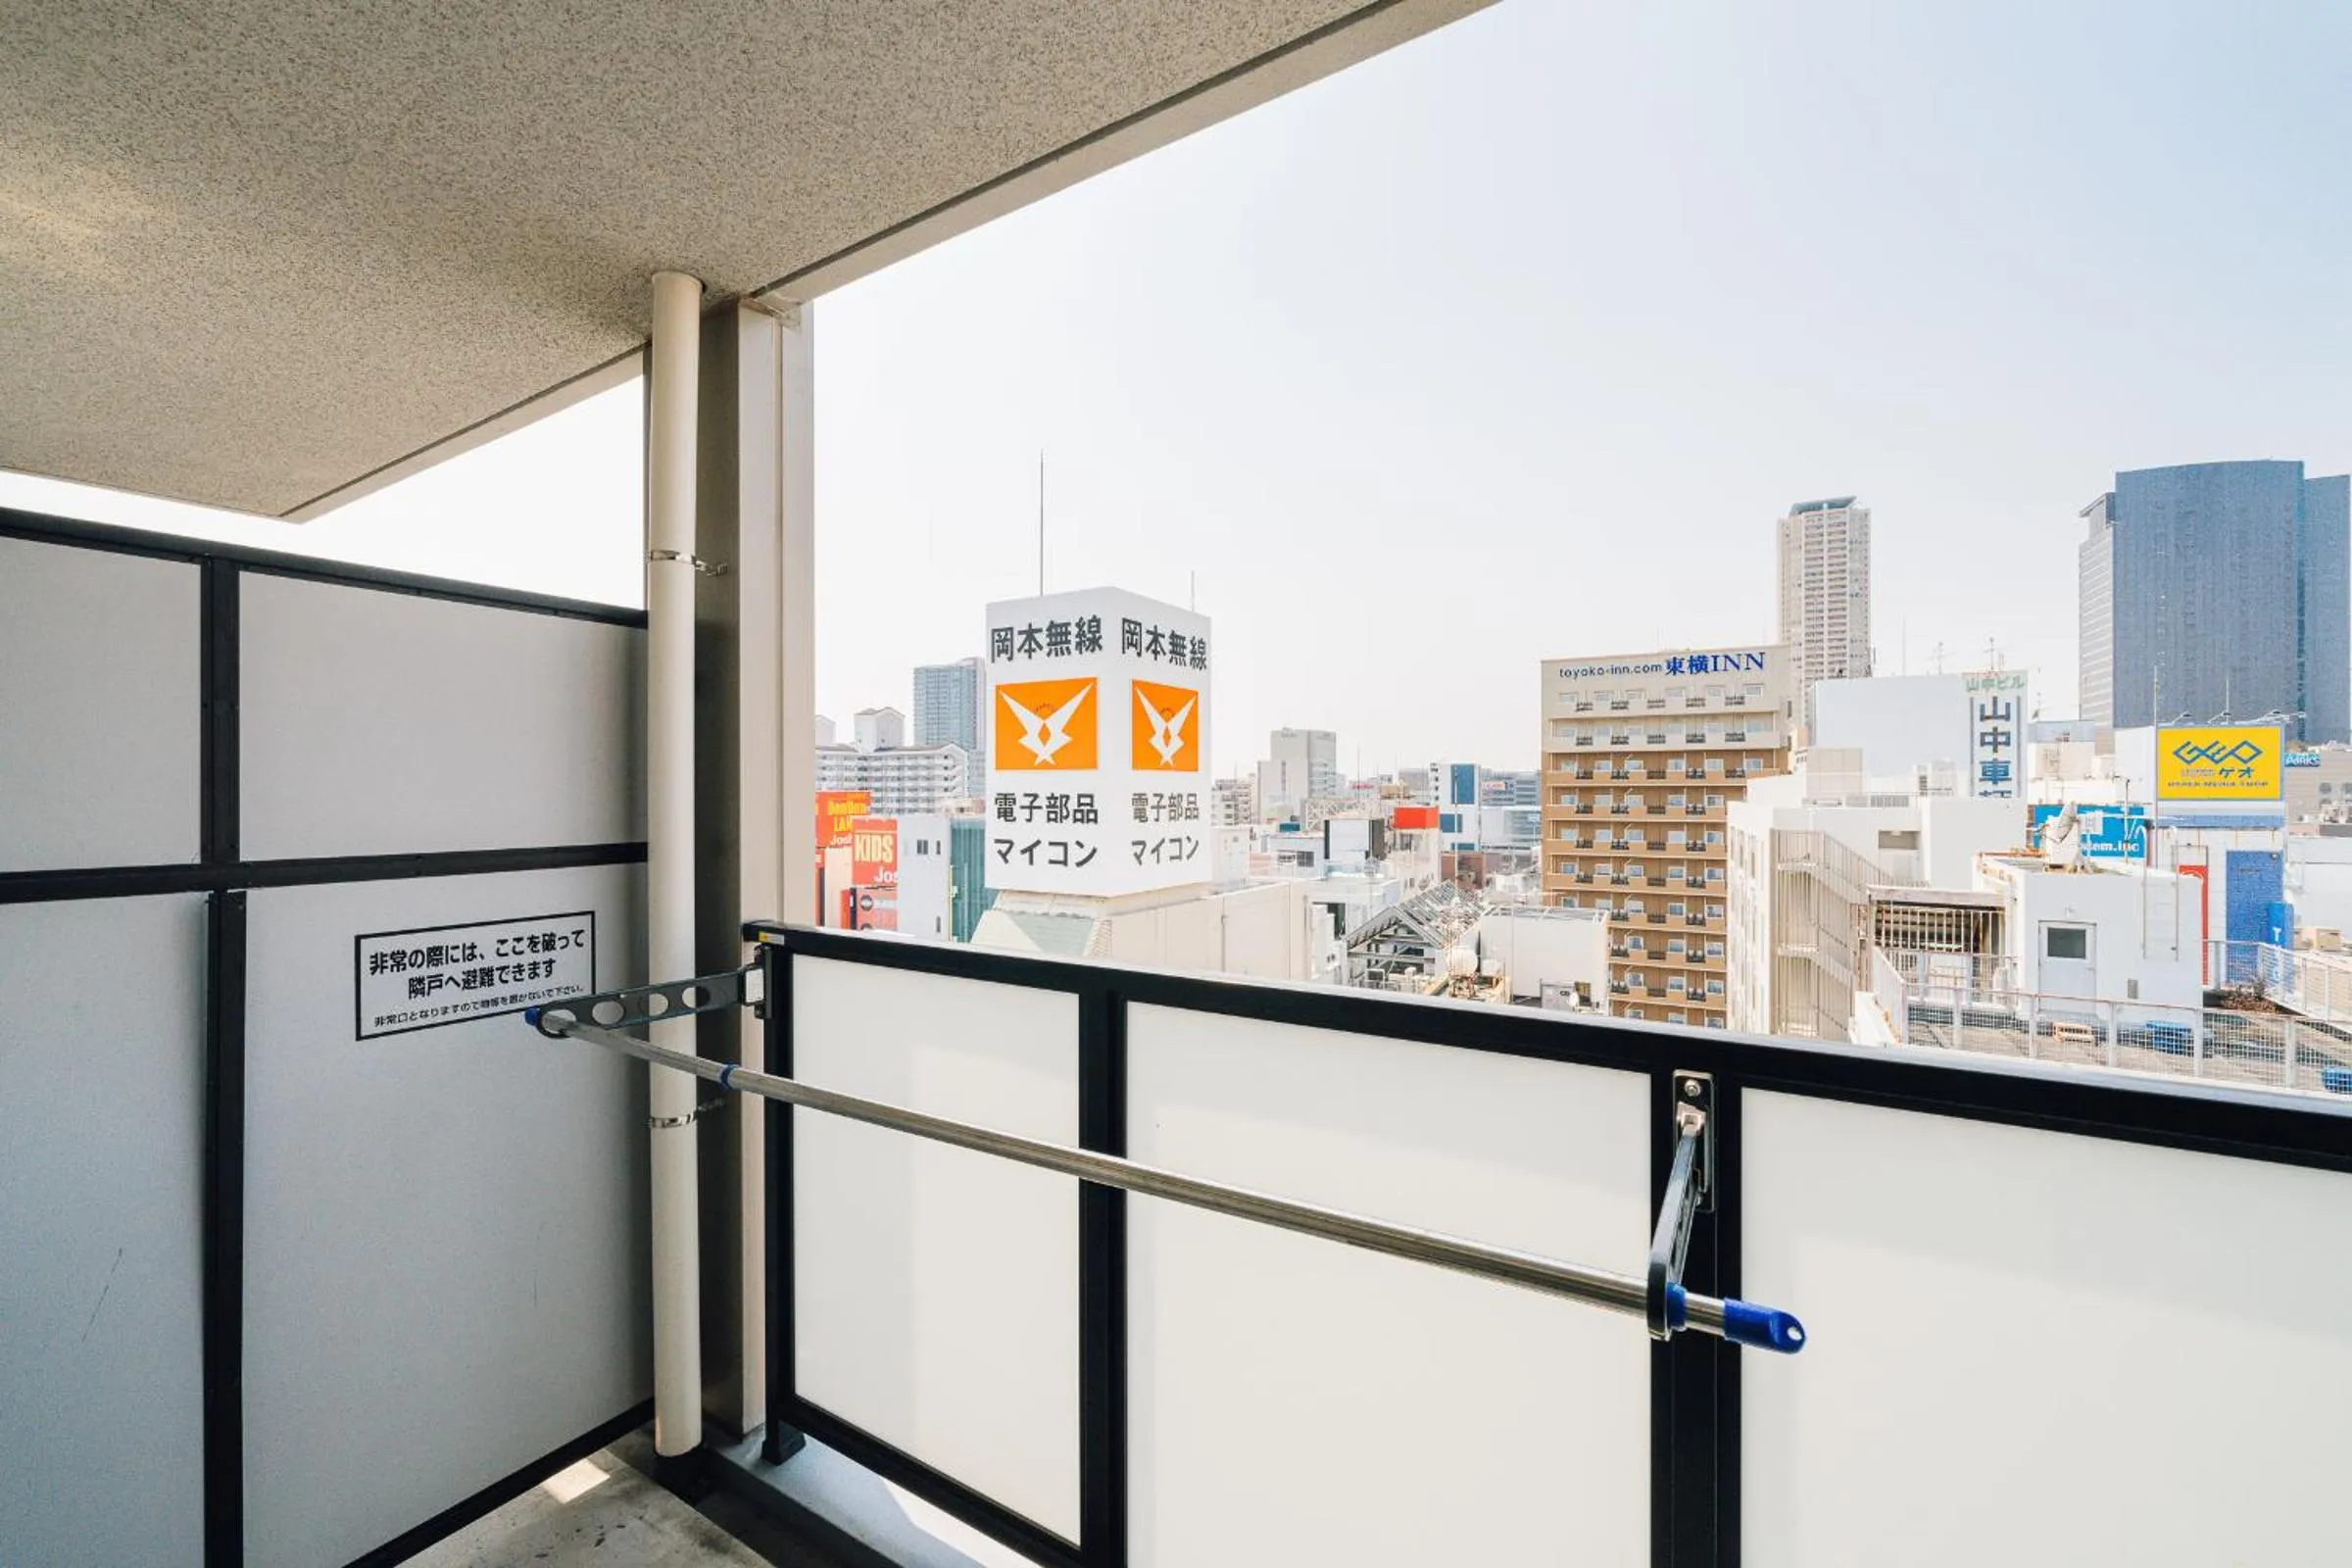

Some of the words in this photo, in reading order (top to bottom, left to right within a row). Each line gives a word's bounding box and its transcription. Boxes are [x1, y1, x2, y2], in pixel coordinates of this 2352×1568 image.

[991, 614, 1103, 663] 岡本無線
[1121, 616, 1207, 671] 岡本無線
[1559, 662, 1663, 680] toyoko-inn.com
[1666, 652, 1766, 676] 東横INN
[2173, 740, 2264, 765] GEO
[995, 793, 1099, 824] 電子部品
[1132, 793, 1199, 822] 電子部品
[855, 834, 894, 863] KIDS
[994, 838, 1098, 867] マイコン
[1132, 835, 1199, 864] マイコン
[369, 929, 586, 975] 非常の際には、ここを破って
[408, 957, 557, 1000] 隣戸へ避難できます
